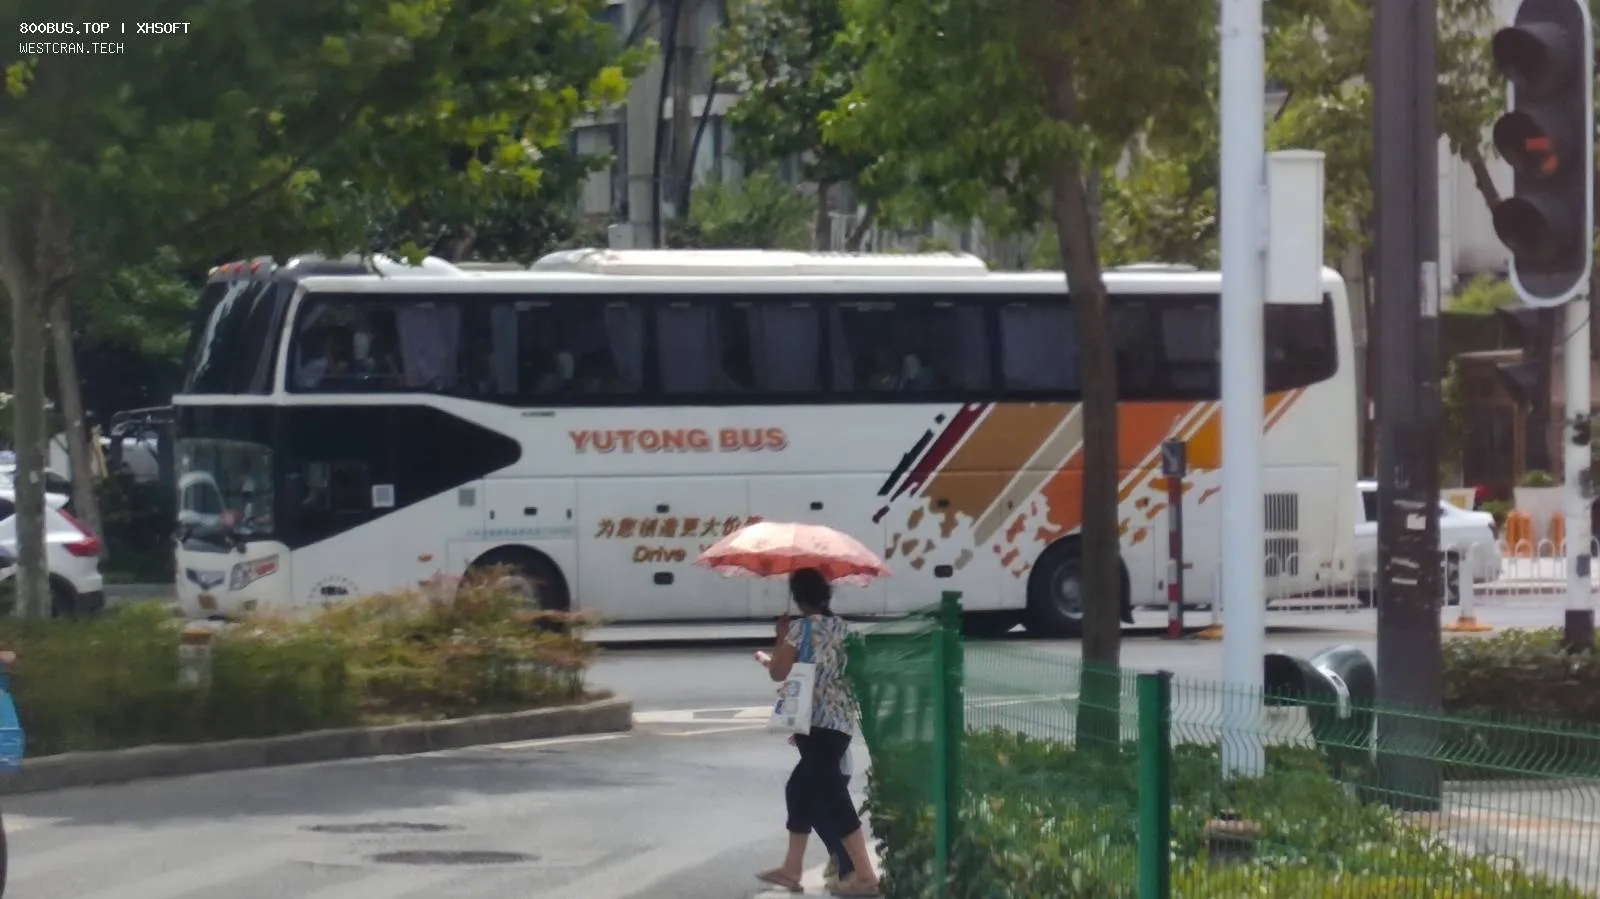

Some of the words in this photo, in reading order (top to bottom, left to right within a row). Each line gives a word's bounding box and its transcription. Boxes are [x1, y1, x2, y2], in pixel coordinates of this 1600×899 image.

[568, 428, 711, 453] YUTONG
[718, 427, 788, 452] BUS
[632, 545, 687, 563] Drive
